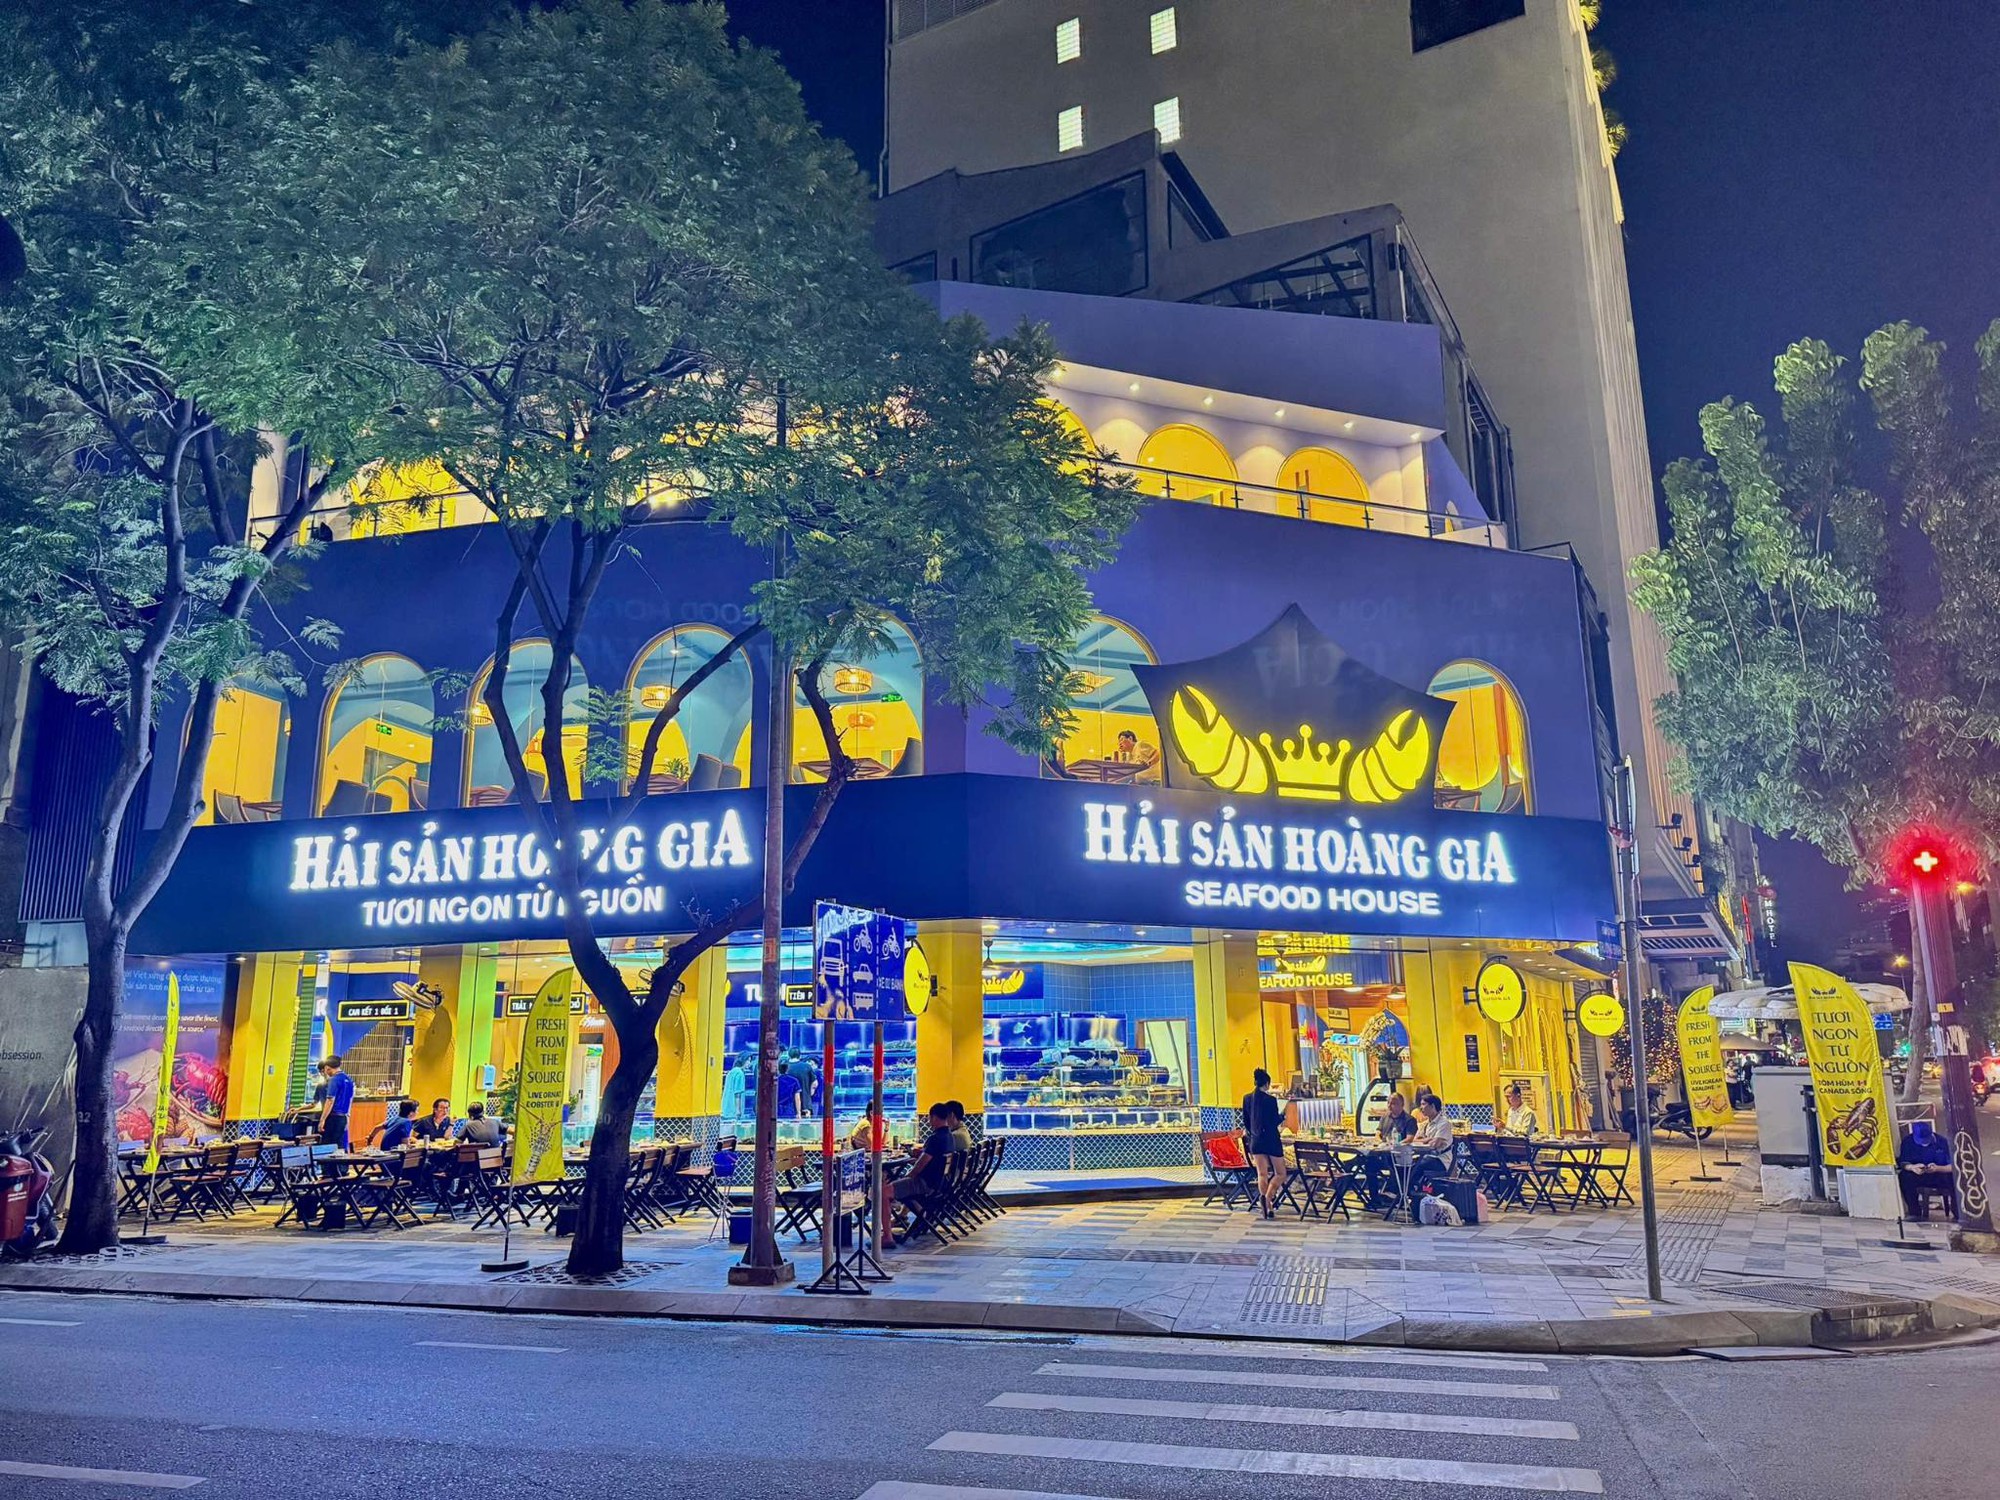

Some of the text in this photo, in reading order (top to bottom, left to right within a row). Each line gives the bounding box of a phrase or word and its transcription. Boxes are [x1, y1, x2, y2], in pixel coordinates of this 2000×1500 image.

[1083, 799, 1516, 884] HẢI SẢN HOÀNG GIA
[289, 826, 381, 890] HẢI
[387, 821, 474, 884] SẢN
[657, 808, 753, 870] GIA
[361, 896, 424, 926] TƯƠI
[427, 894, 512, 924] NGON
[515, 881, 553, 919] TỪ
[1184, 879, 1443, 916] SEAFOOD HOUSE
[1765, 909, 1778, 948] HOTEL
[1306, 972, 1353, 988] HOUSE
[1813, 1011, 1851, 1023] TƯƠI
[536, 1018, 567, 1031] FRESH
[1686, 1021, 1711, 1032] FRESH
[1812, 1028, 1859, 1040] NGON
[535, 1036, 565, 1048] FROM
[1688, 1035, 1712, 1046] FROM
[1696, 1050, 1710, 1060] THE
[1828, 1043, 1850, 1056] TỪ
[540, 1053, 559, 1065] THE
[1688, 1063, 1721, 1075] SOURCE
[1819, 1087, 1850, 1095] CANADA
